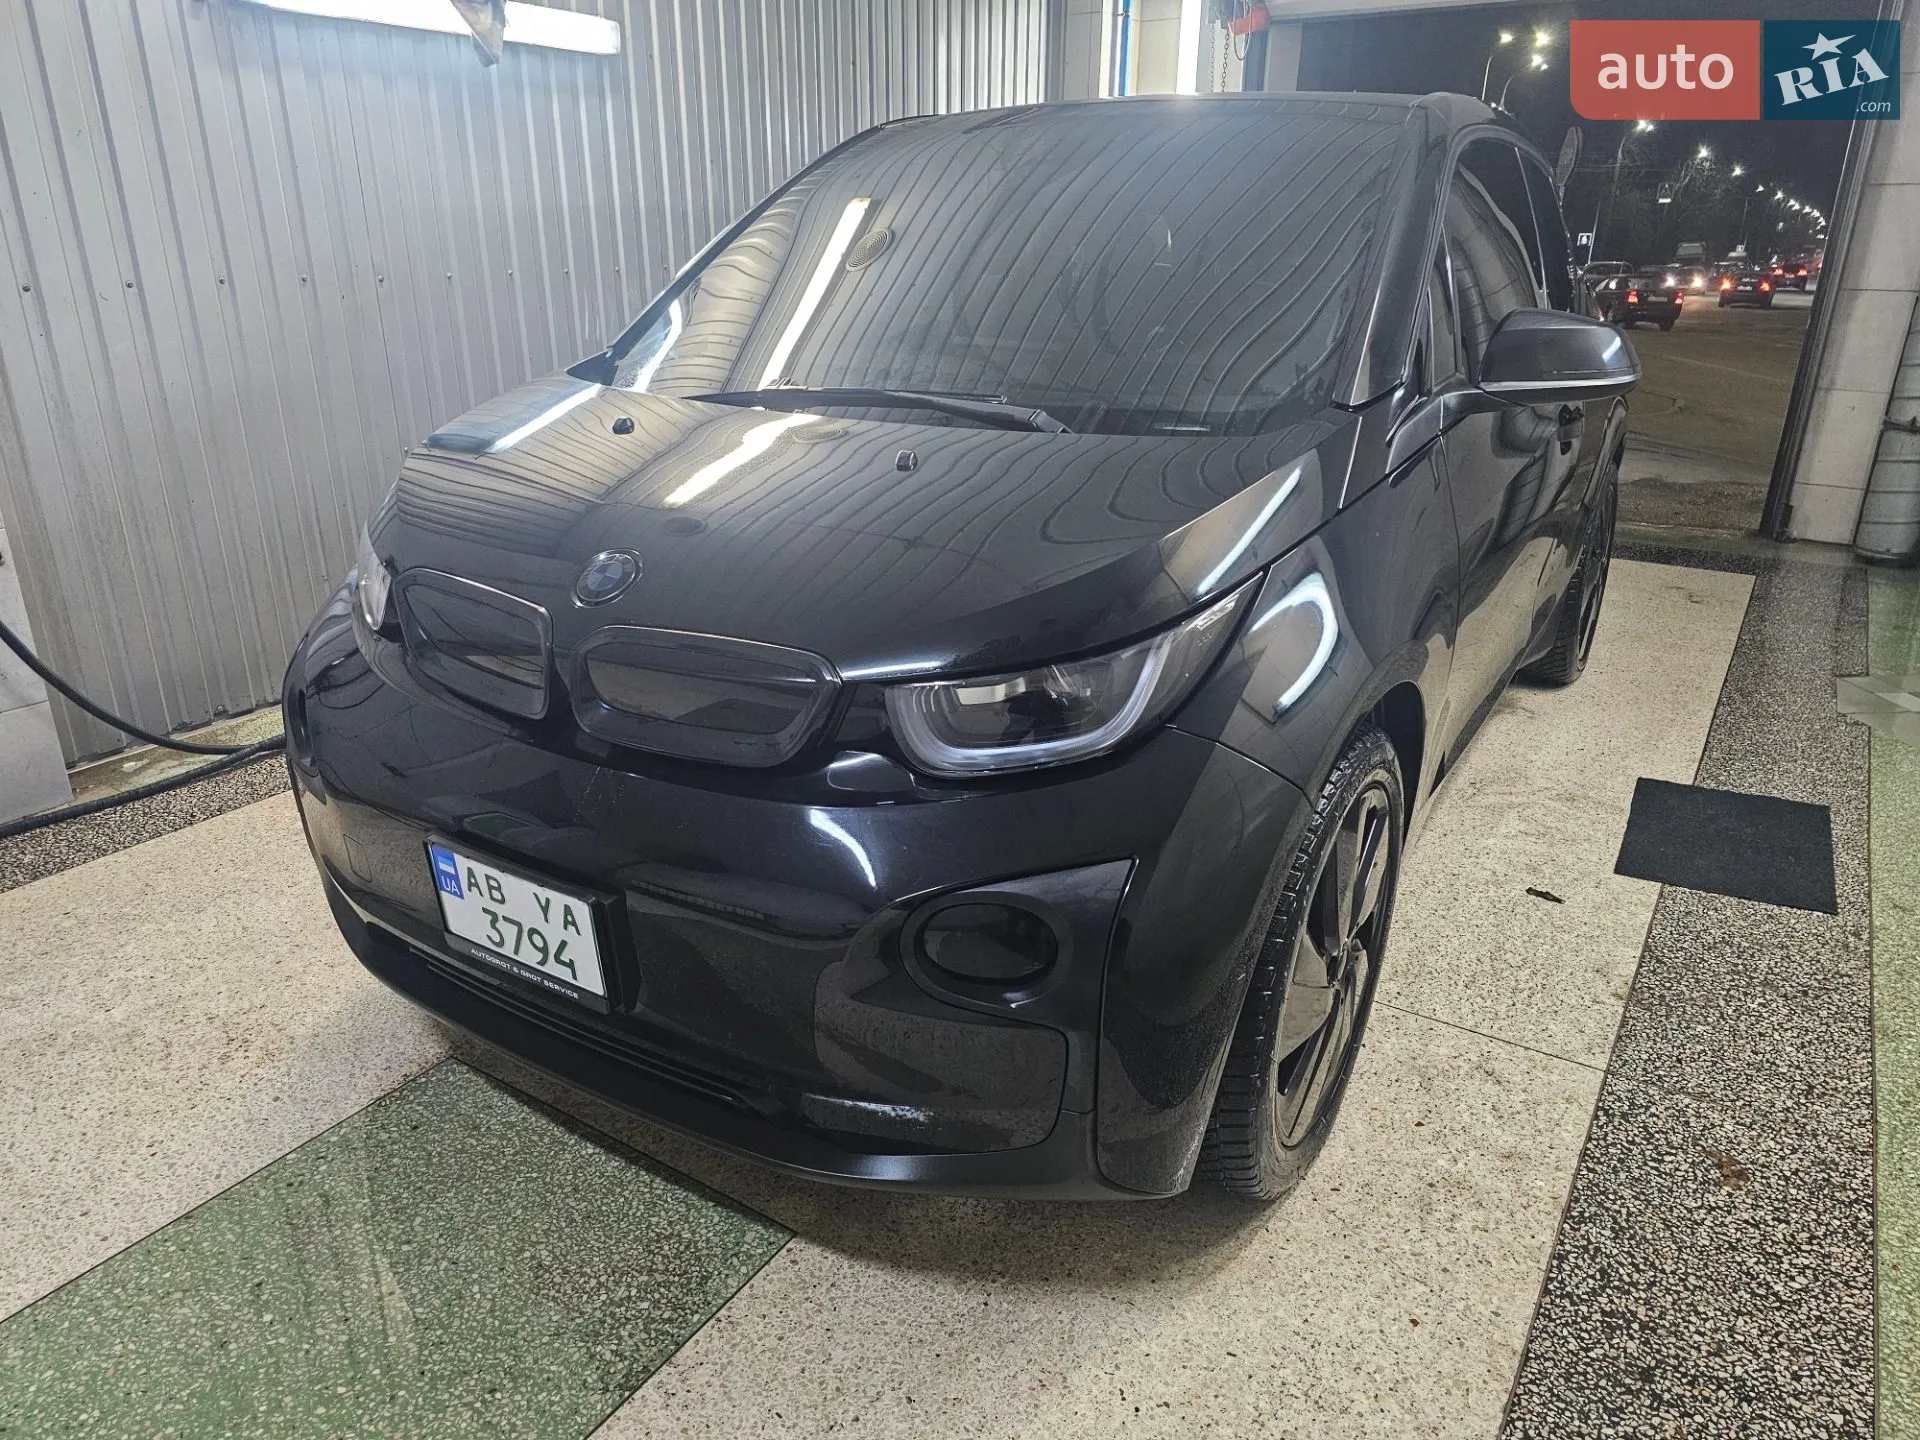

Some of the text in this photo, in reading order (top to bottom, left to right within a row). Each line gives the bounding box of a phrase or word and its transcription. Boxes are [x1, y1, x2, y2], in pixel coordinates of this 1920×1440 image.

[440, 877, 460, 895] UA
[467, 867, 581, 936] AB YA
[482, 907, 578, 981] 3794
[543, 980, 579, 1000] SERVICE
